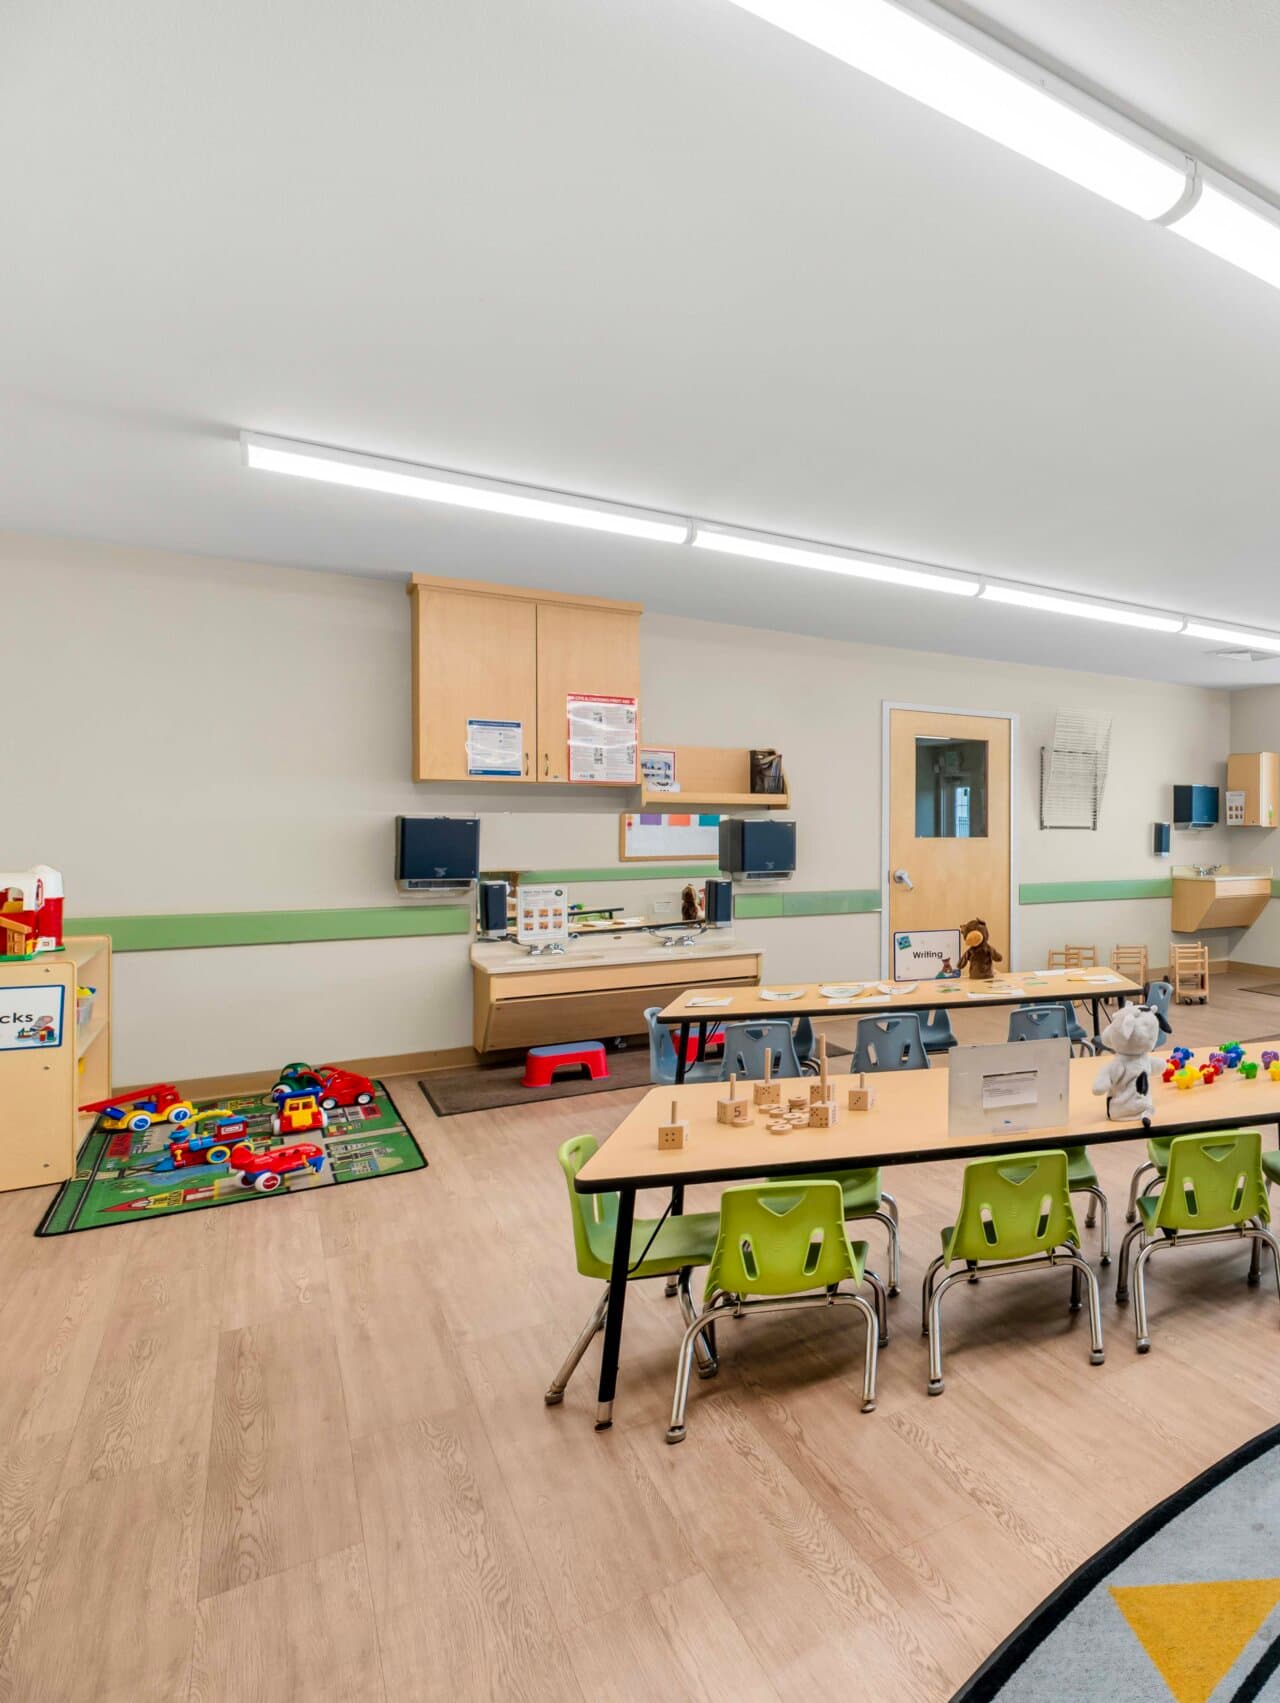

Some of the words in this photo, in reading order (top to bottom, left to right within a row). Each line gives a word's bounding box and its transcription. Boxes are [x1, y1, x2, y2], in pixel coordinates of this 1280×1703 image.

[912, 951, 943, 959] Writing
[0, 1012, 34, 1024] cks
[734, 1106, 741, 1118] 5
